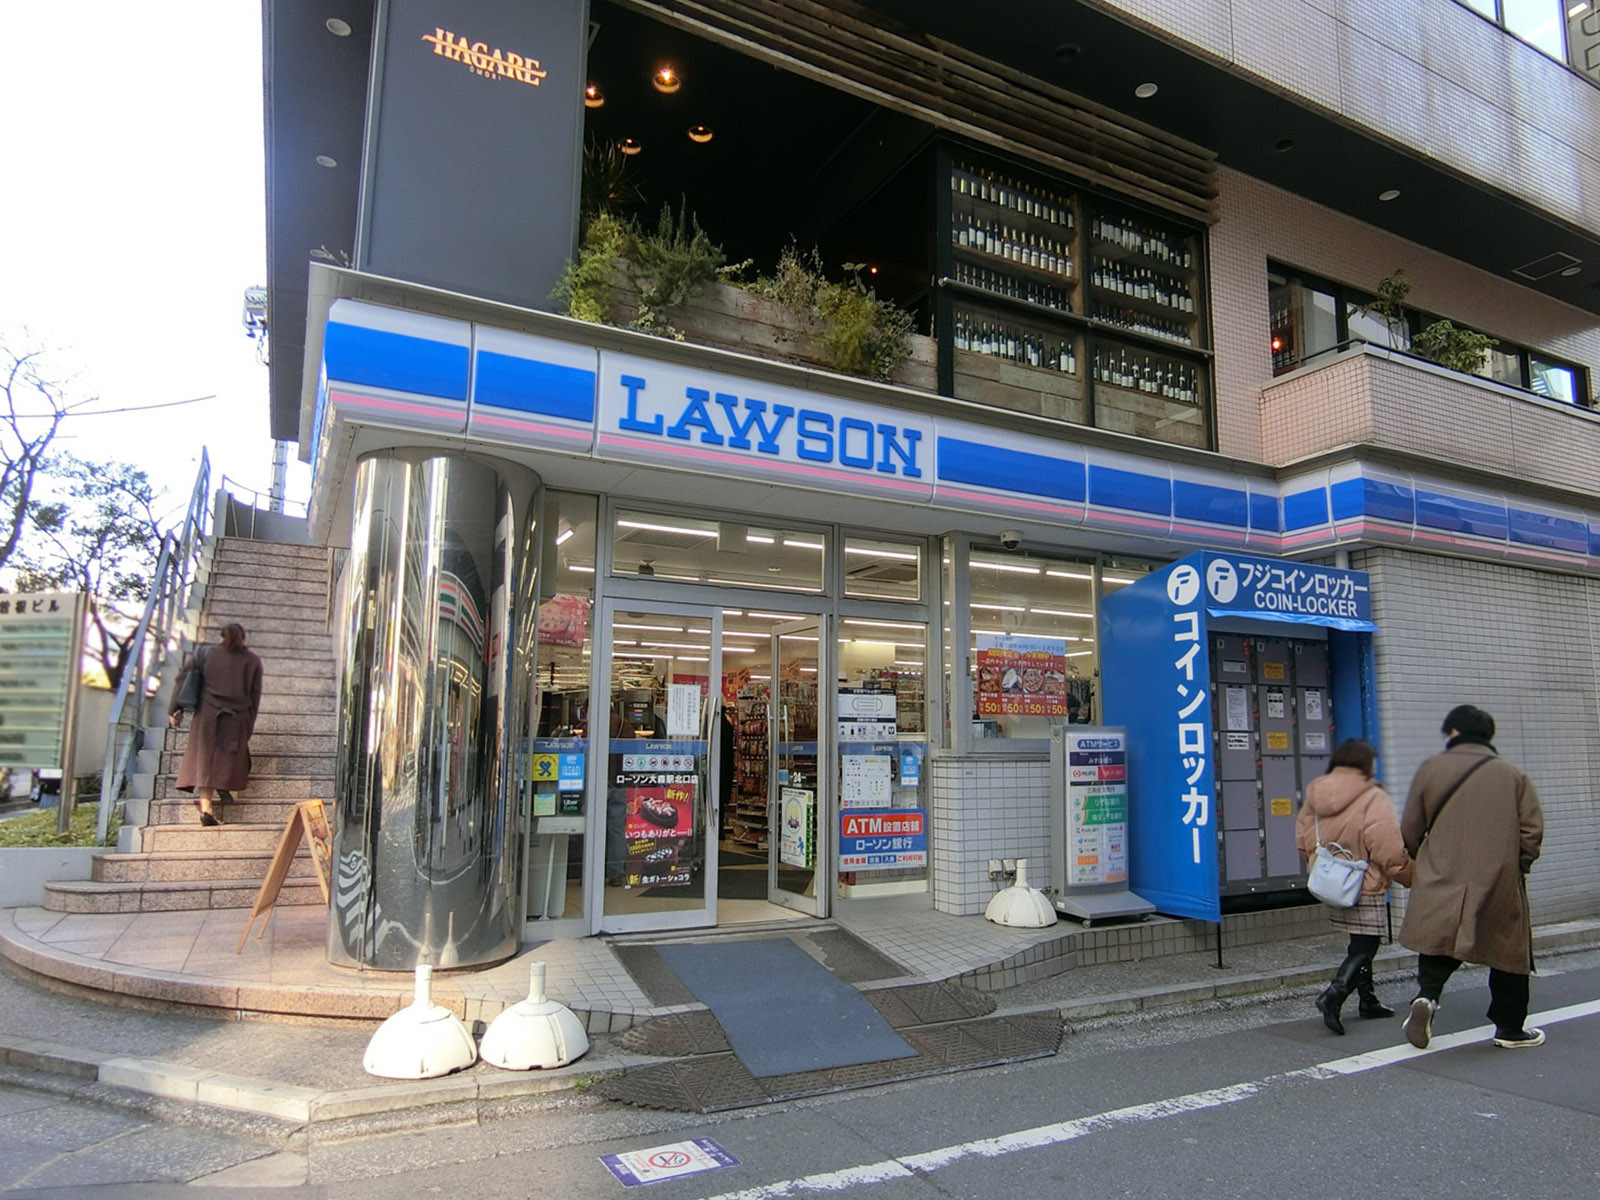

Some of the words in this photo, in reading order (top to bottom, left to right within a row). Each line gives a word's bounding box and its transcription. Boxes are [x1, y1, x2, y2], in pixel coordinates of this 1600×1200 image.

[424, 27, 546, 87] HAGARE
[618, 373, 924, 479] LAWSON
[1238, 562, 1369, 600] フジコインロッカー
[1254, 590, 1358, 618] COIN-LOCKER
[1173, 610, 1209, 864] コインロッカー
[616, 773, 699, 784] ローソン大森駅北口店
[847, 817, 920, 834] ATM設置店舗
[855, 836, 913, 851] ローソン銀行
